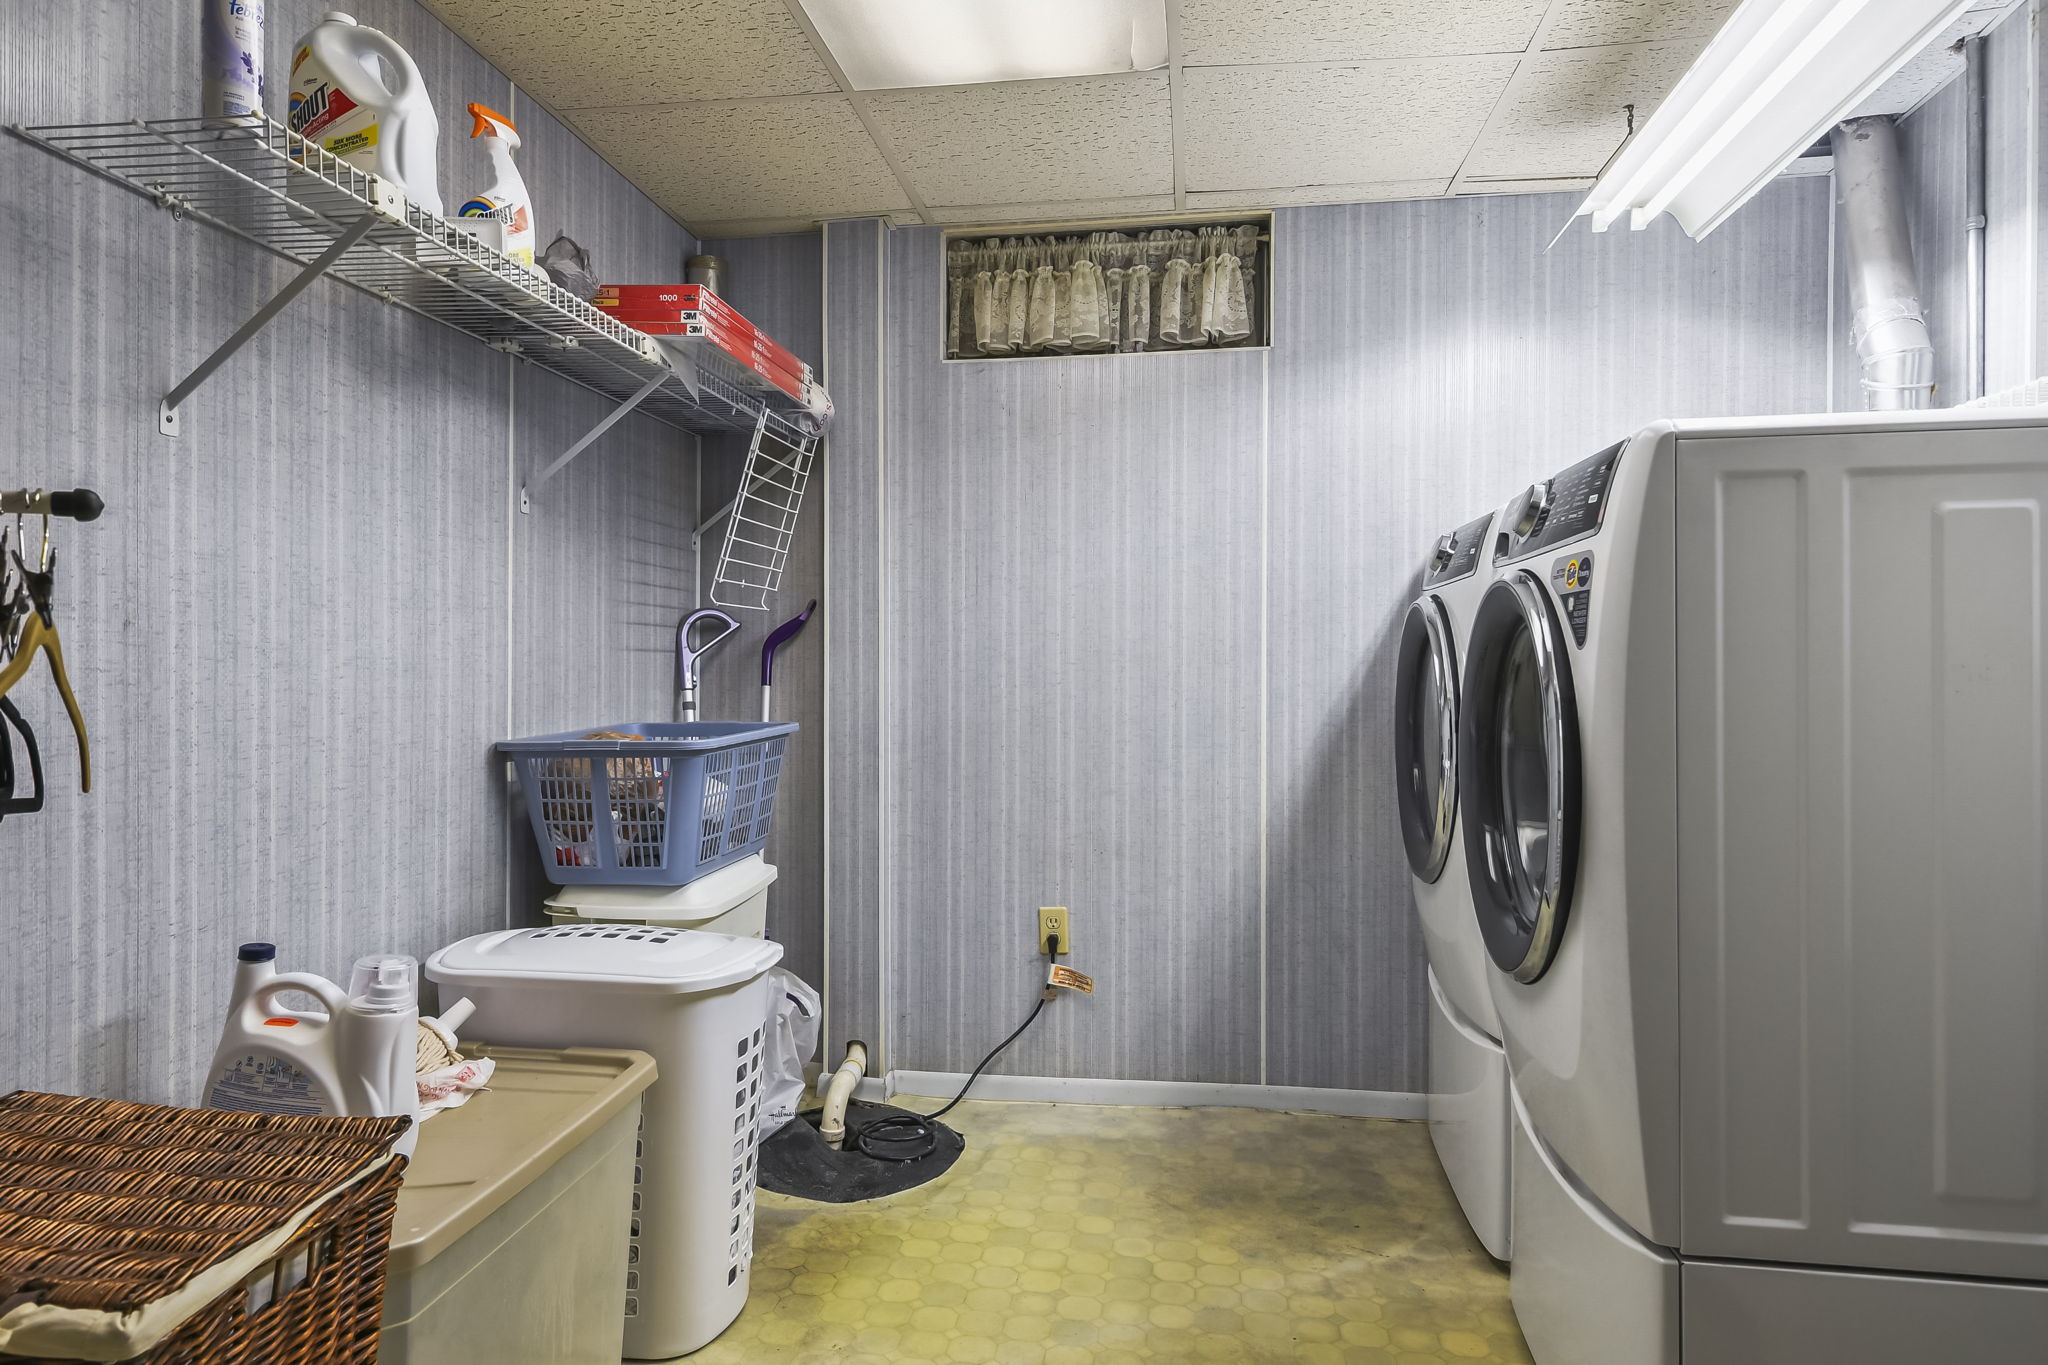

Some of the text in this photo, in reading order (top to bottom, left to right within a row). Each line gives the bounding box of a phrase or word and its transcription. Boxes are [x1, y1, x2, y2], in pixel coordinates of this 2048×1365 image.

[291, 82, 328, 133] SHOUT
[345, 133, 362, 142] MORE
[659, 294, 678, 302] 1000
[683, 312, 697, 320] 3M
[689, 325, 703, 333] 3M
[768, 1110, 797, 1122] Hallmar
